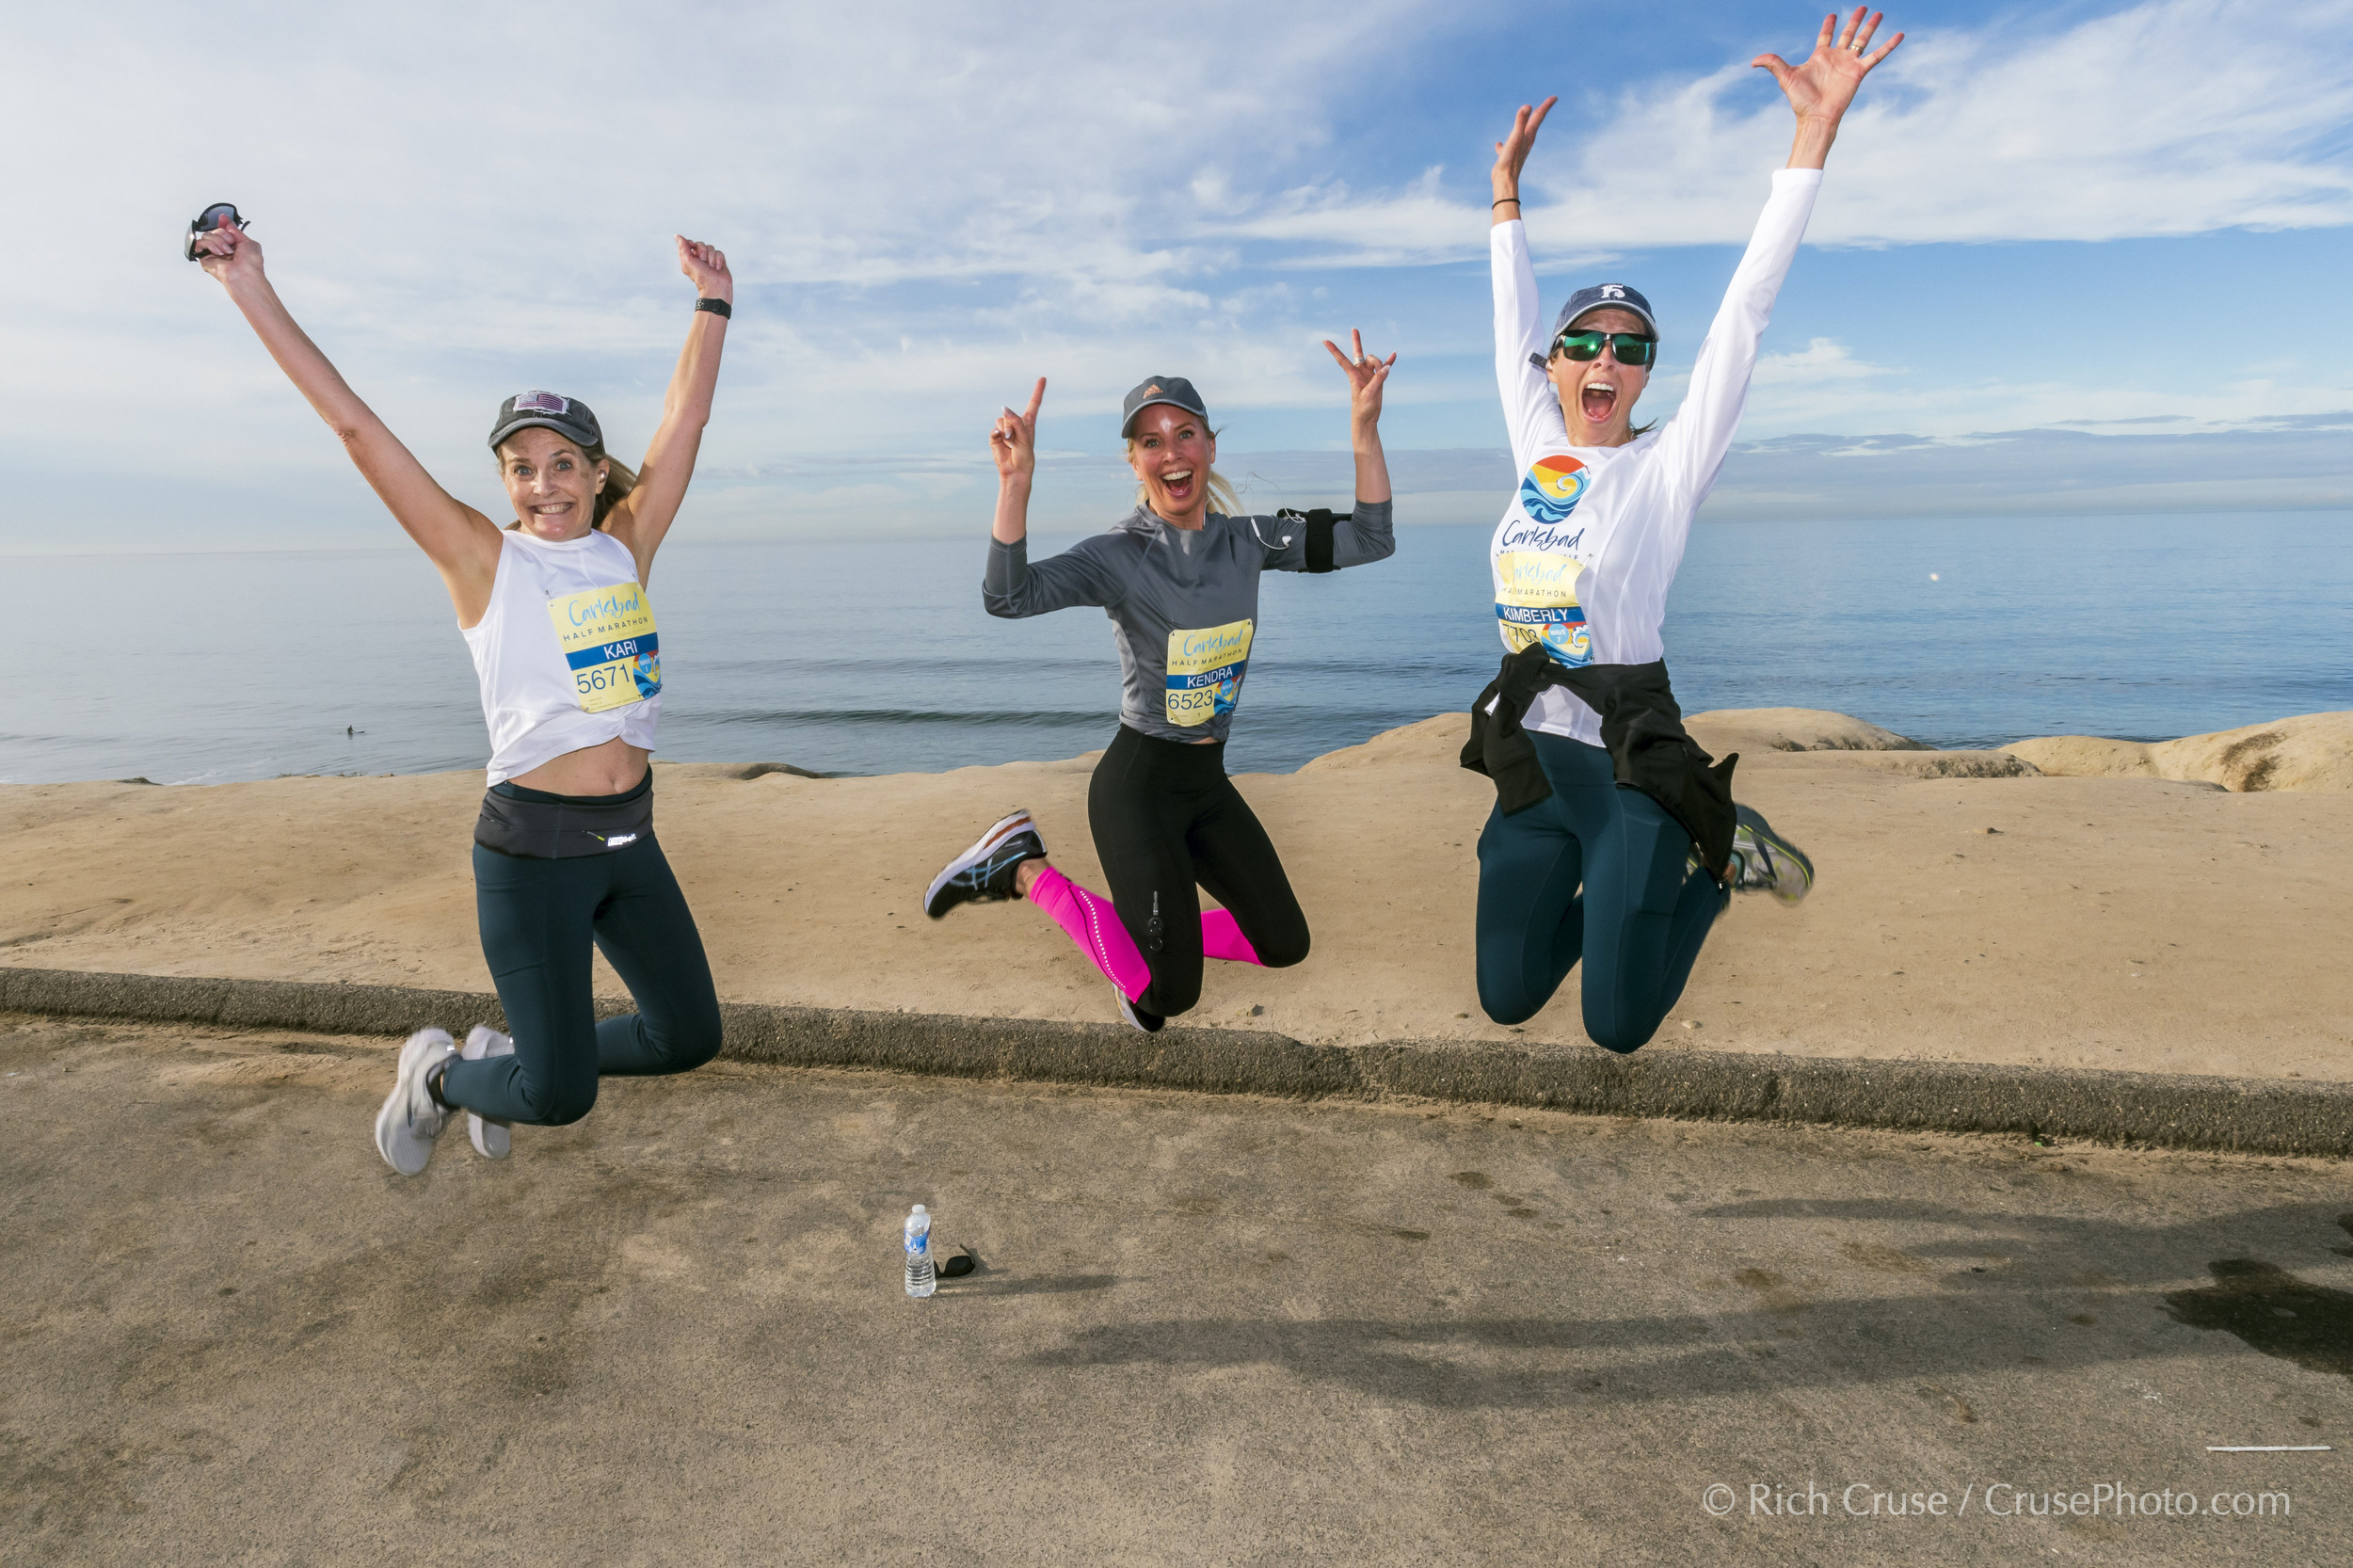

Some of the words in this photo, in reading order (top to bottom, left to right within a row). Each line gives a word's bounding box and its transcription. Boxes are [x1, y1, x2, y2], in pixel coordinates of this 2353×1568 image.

[1502, 520, 1585, 552] Carlsbad
[1513, 561, 1567, 585] arlsbad
[1517, 588, 1566, 598] MARATHON
[568, 591, 641, 627] Carlsbad
[1503, 607, 1568, 622] KIMBERLY
[563, 629, 594, 642] HALF
[598, 616, 648, 632] MARATHON
[603, 639, 638, 660] KARI
[1183, 629, 1242, 657] Carlsbad
[1201, 648, 1242, 664] MARATHON
[576, 664, 630, 694] 5671
[1187, 666, 1233, 689] KENDRA
[1167, 689, 1213, 710] 6523
